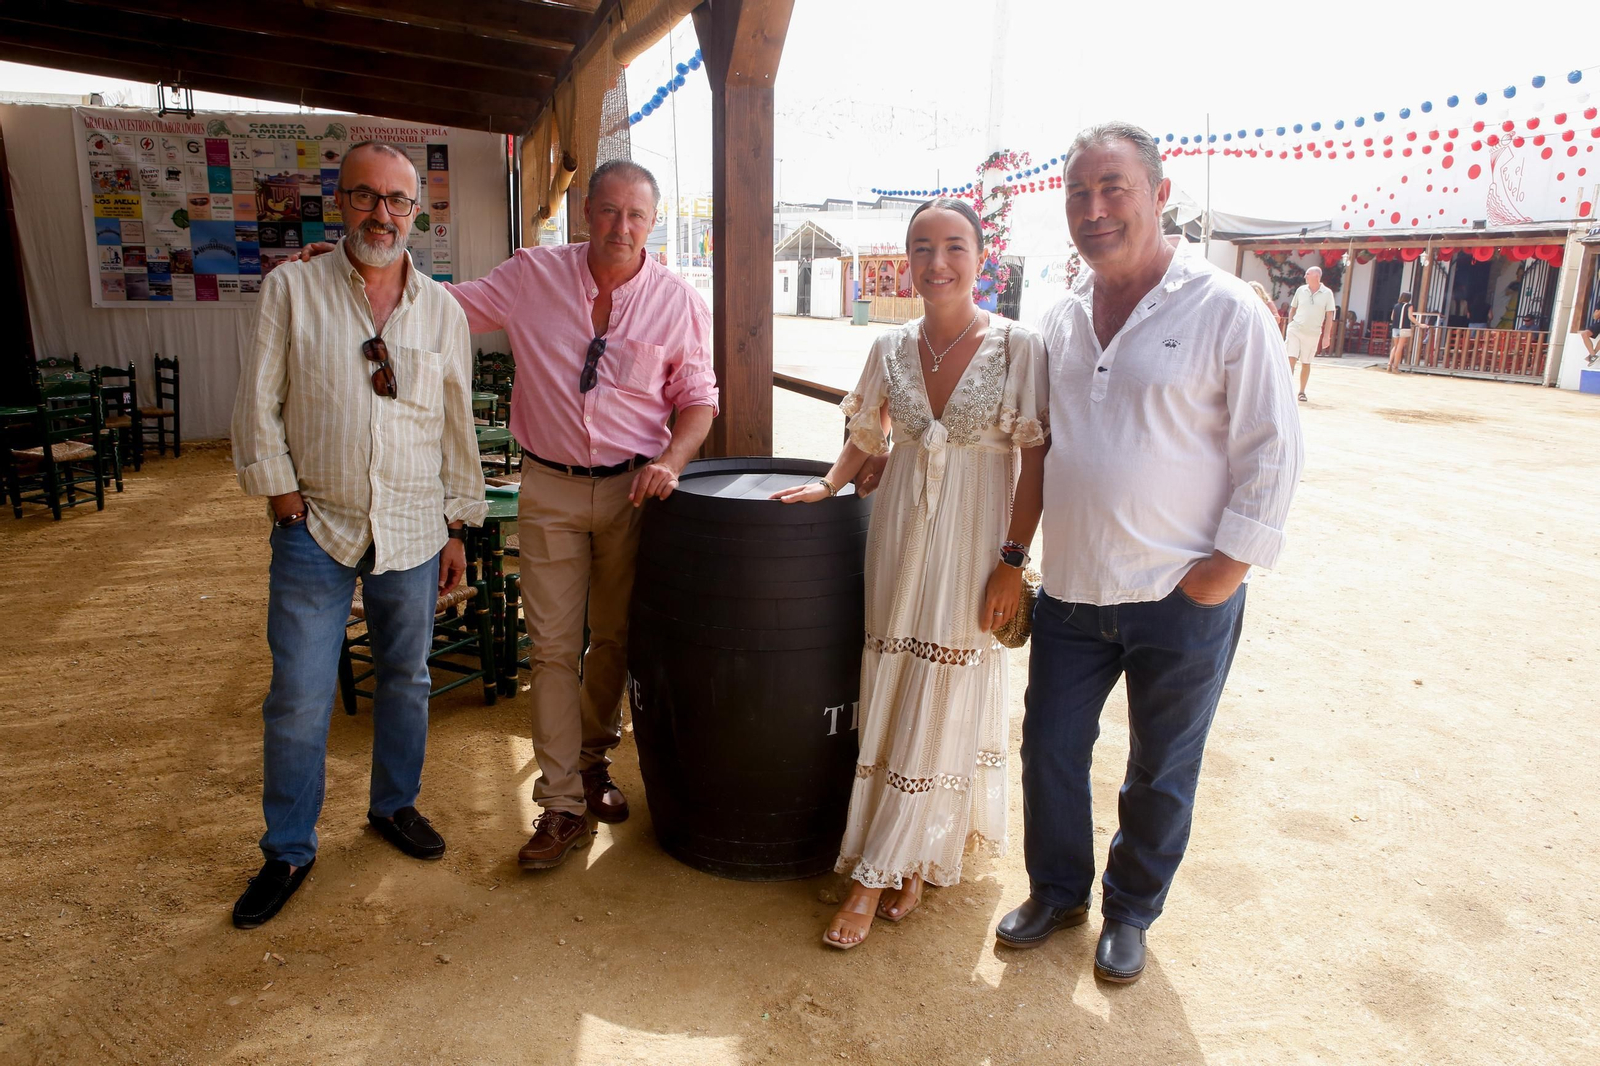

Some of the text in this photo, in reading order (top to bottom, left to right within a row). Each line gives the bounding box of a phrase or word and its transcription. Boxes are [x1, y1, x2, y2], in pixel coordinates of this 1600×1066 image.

[84, 116, 113, 130] GRACIAS
[119, 119, 151, 132] NUESTROS
[152, 120, 205, 135] COLABORADORES
[350, 126, 448, 137] SIN VOSOTROS SERÍA
[351, 134, 373, 142] CASI
